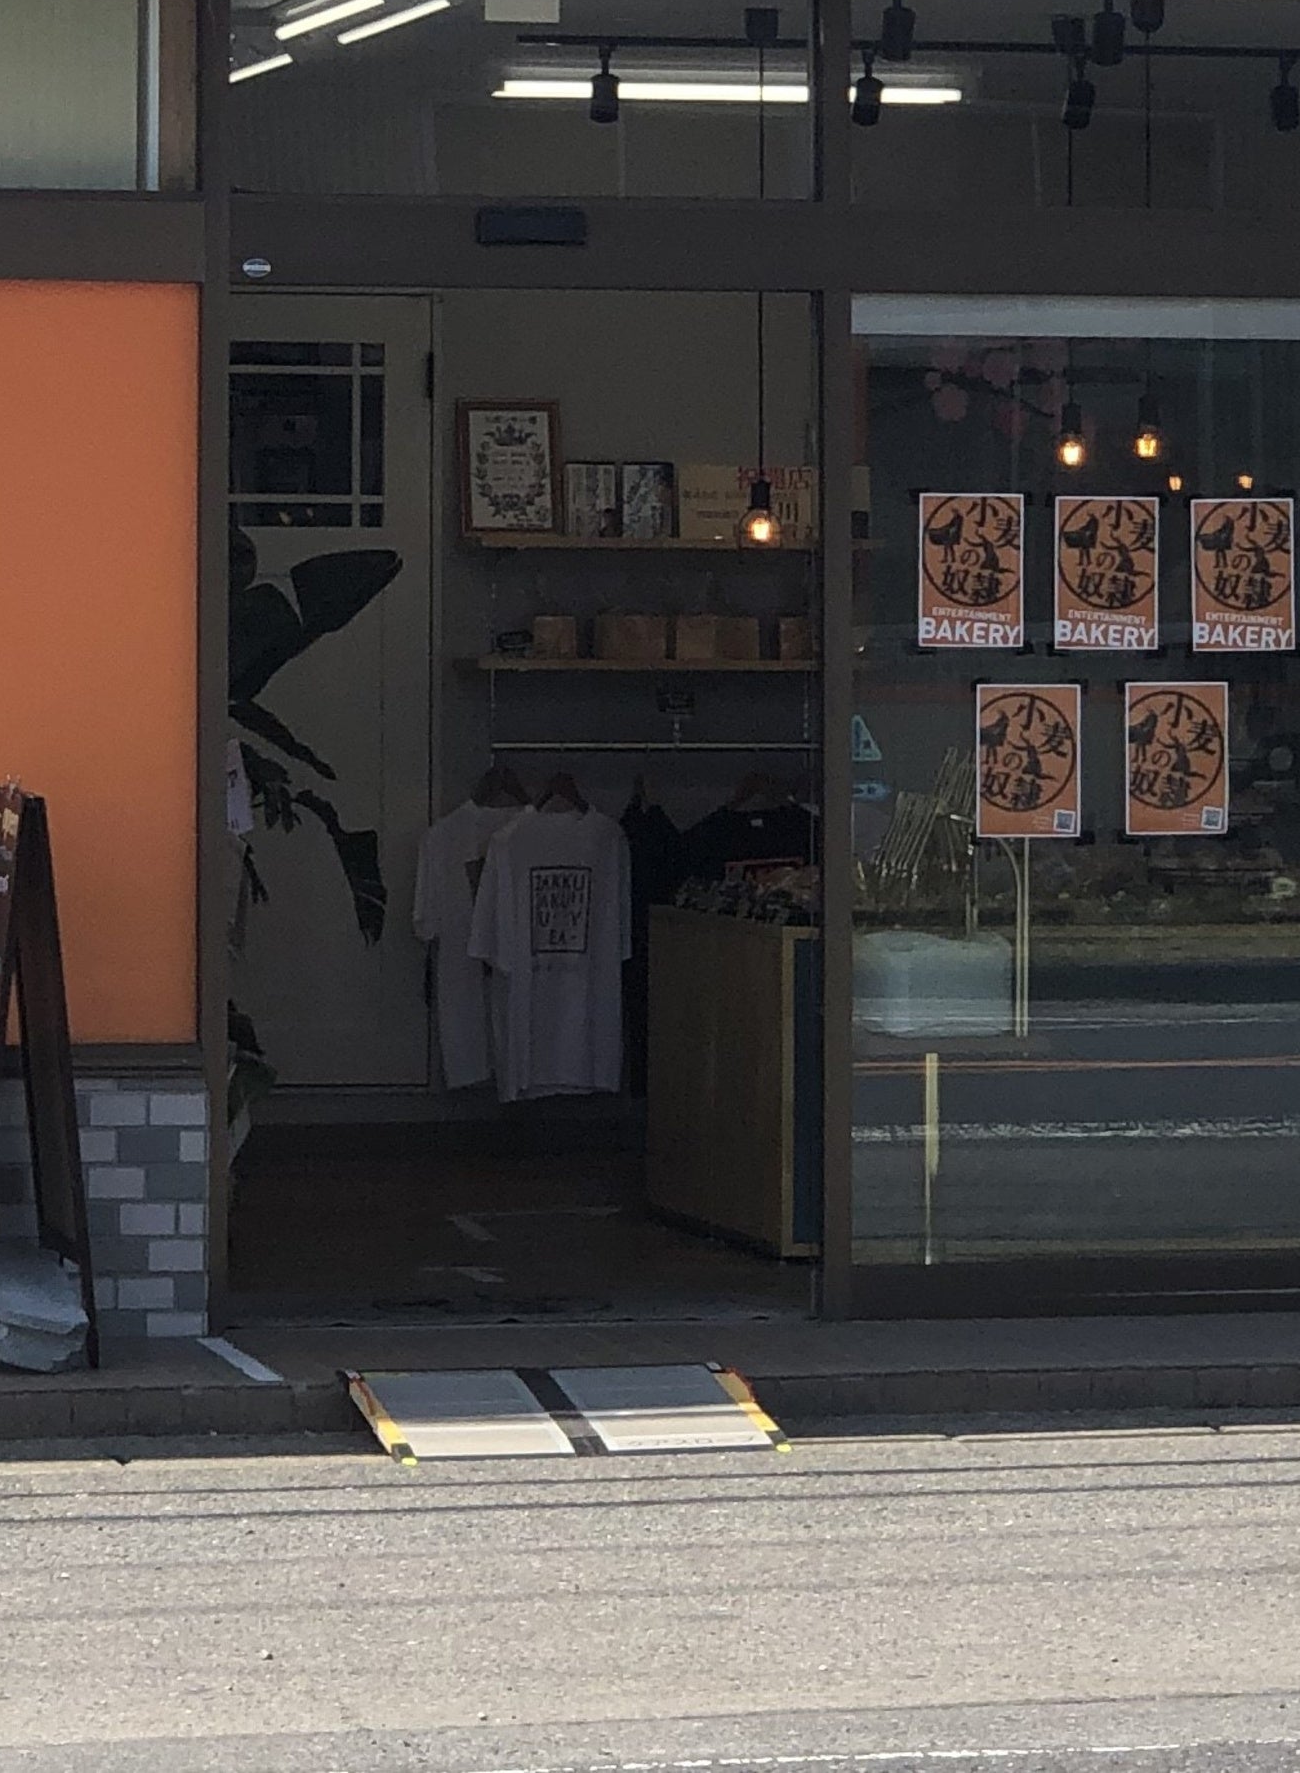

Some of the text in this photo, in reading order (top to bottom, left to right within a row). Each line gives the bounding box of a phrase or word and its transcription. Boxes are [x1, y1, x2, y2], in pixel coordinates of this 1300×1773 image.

[931, 605, 1012, 621] ENTERTAINMENT
[1068, 609, 1148, 624] ENTERTAINMENT
[1205, 611, 1284, 626] ENTERTAINMENT
[921, 616, 1020, 647] BAKERY
[1056, 619, 1155, 649] BAKERY
[1194, 622, 1293, 650] BAKERY
